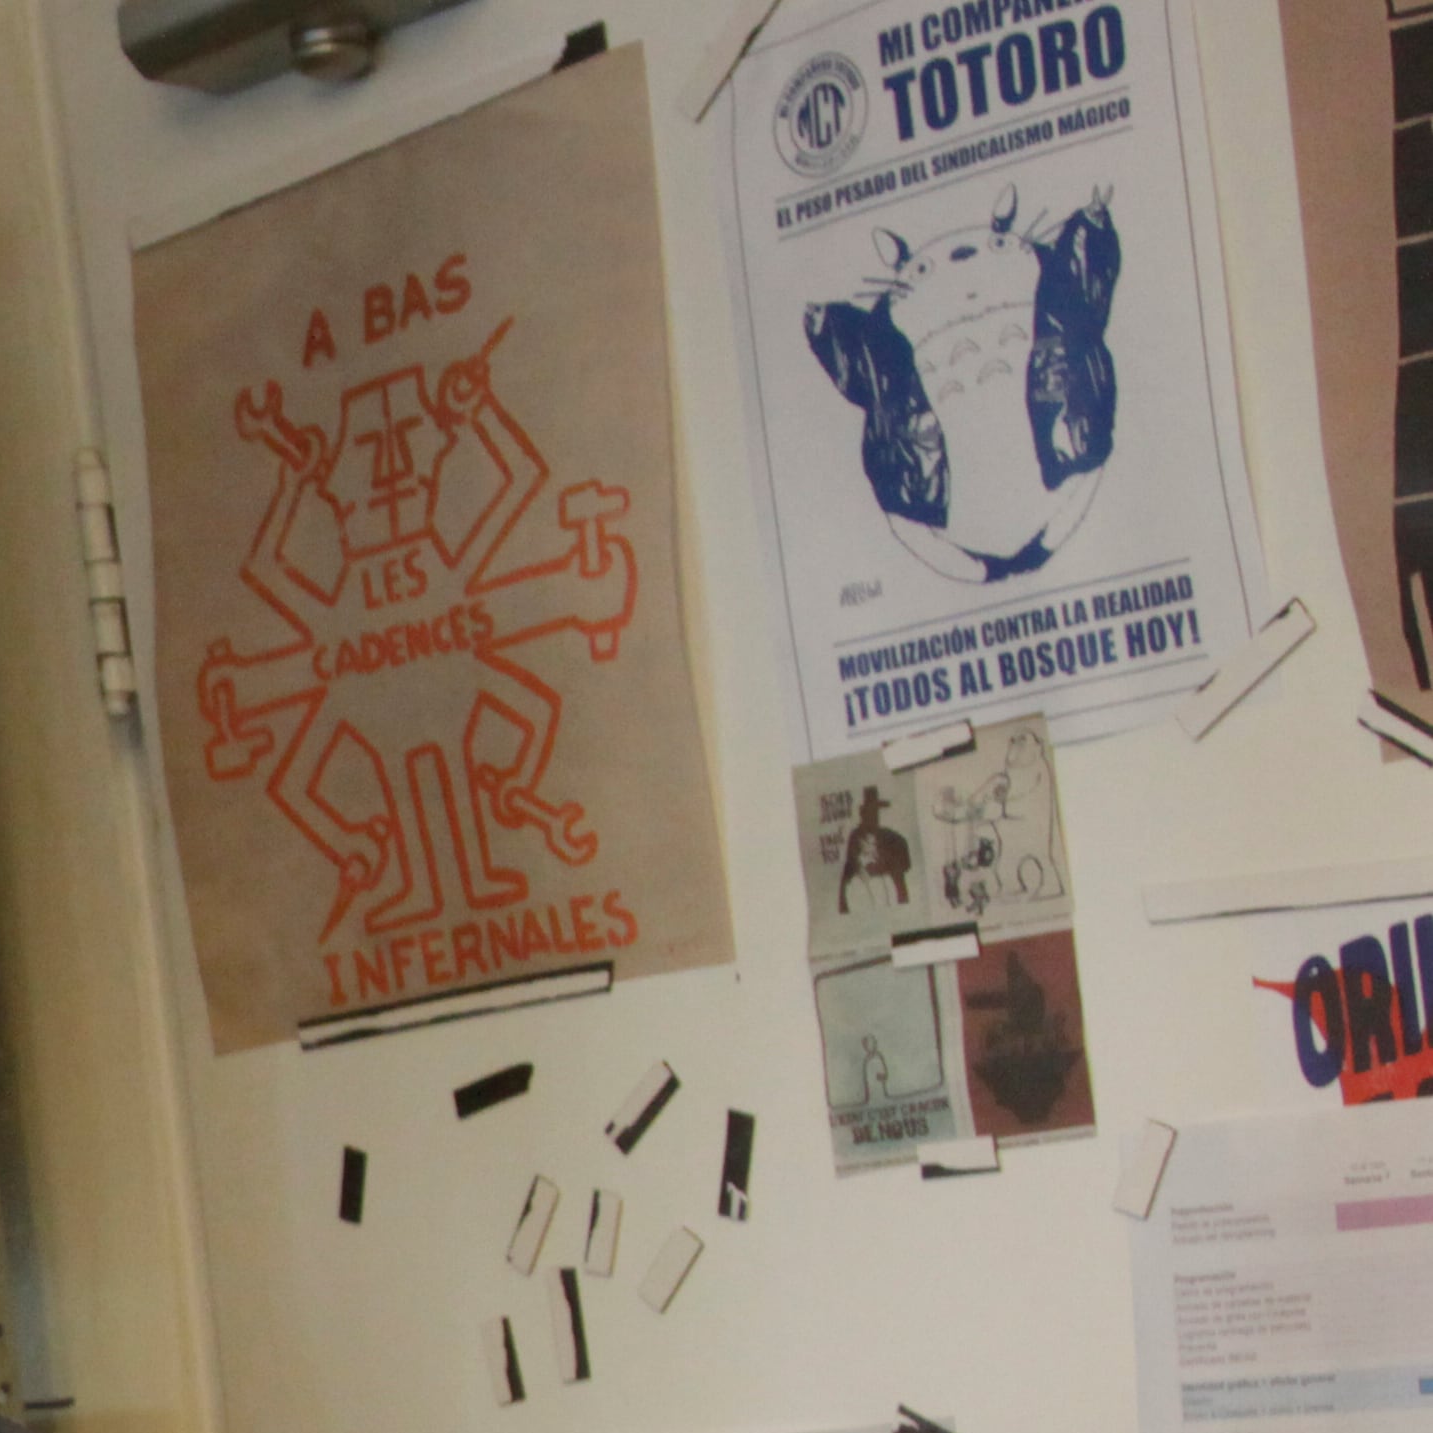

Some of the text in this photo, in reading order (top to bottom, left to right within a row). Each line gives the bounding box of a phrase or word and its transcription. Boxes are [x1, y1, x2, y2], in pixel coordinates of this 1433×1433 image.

[878, 22, 915, 68] MI
[882, 4, 1126, 142] TOTORO
[776, 96, 1131, 229] EL PESO PESADO DEL SINDICALISMO MÁGICO
[302, 251, 473, 369] A BAS
[360, 547, 429, 609] LES
[837, 574, 1195, 683] MOVILIZACIÓN CONTRA LA REALIDAD
[310, 600, 497, 681] CADENCES
[843, 608, 1202, 727] ¡TODOS AL BOSQUE HOY!
[323, 889, 640, 1005] INFERNALES
